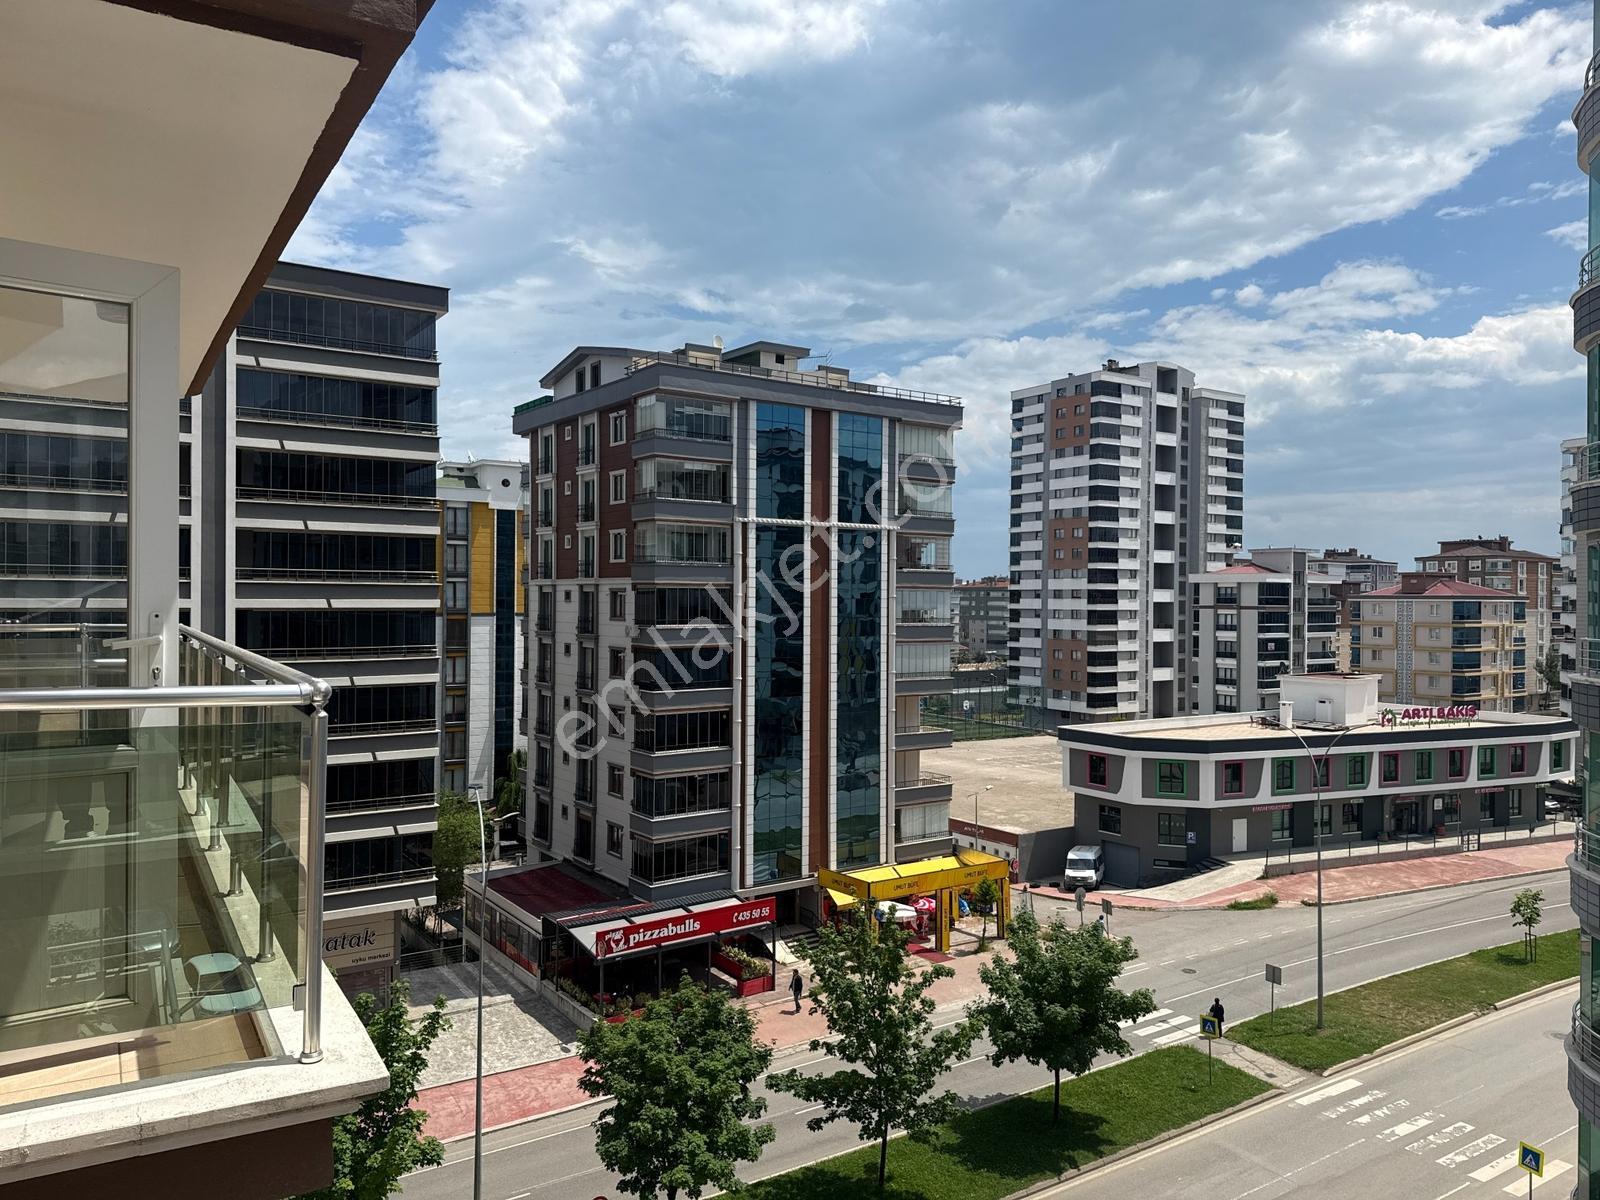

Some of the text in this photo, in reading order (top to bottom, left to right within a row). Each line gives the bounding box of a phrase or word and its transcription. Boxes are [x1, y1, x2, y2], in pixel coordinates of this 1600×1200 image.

[629, 907, 770, 946] pizzabulls 435 50 55
